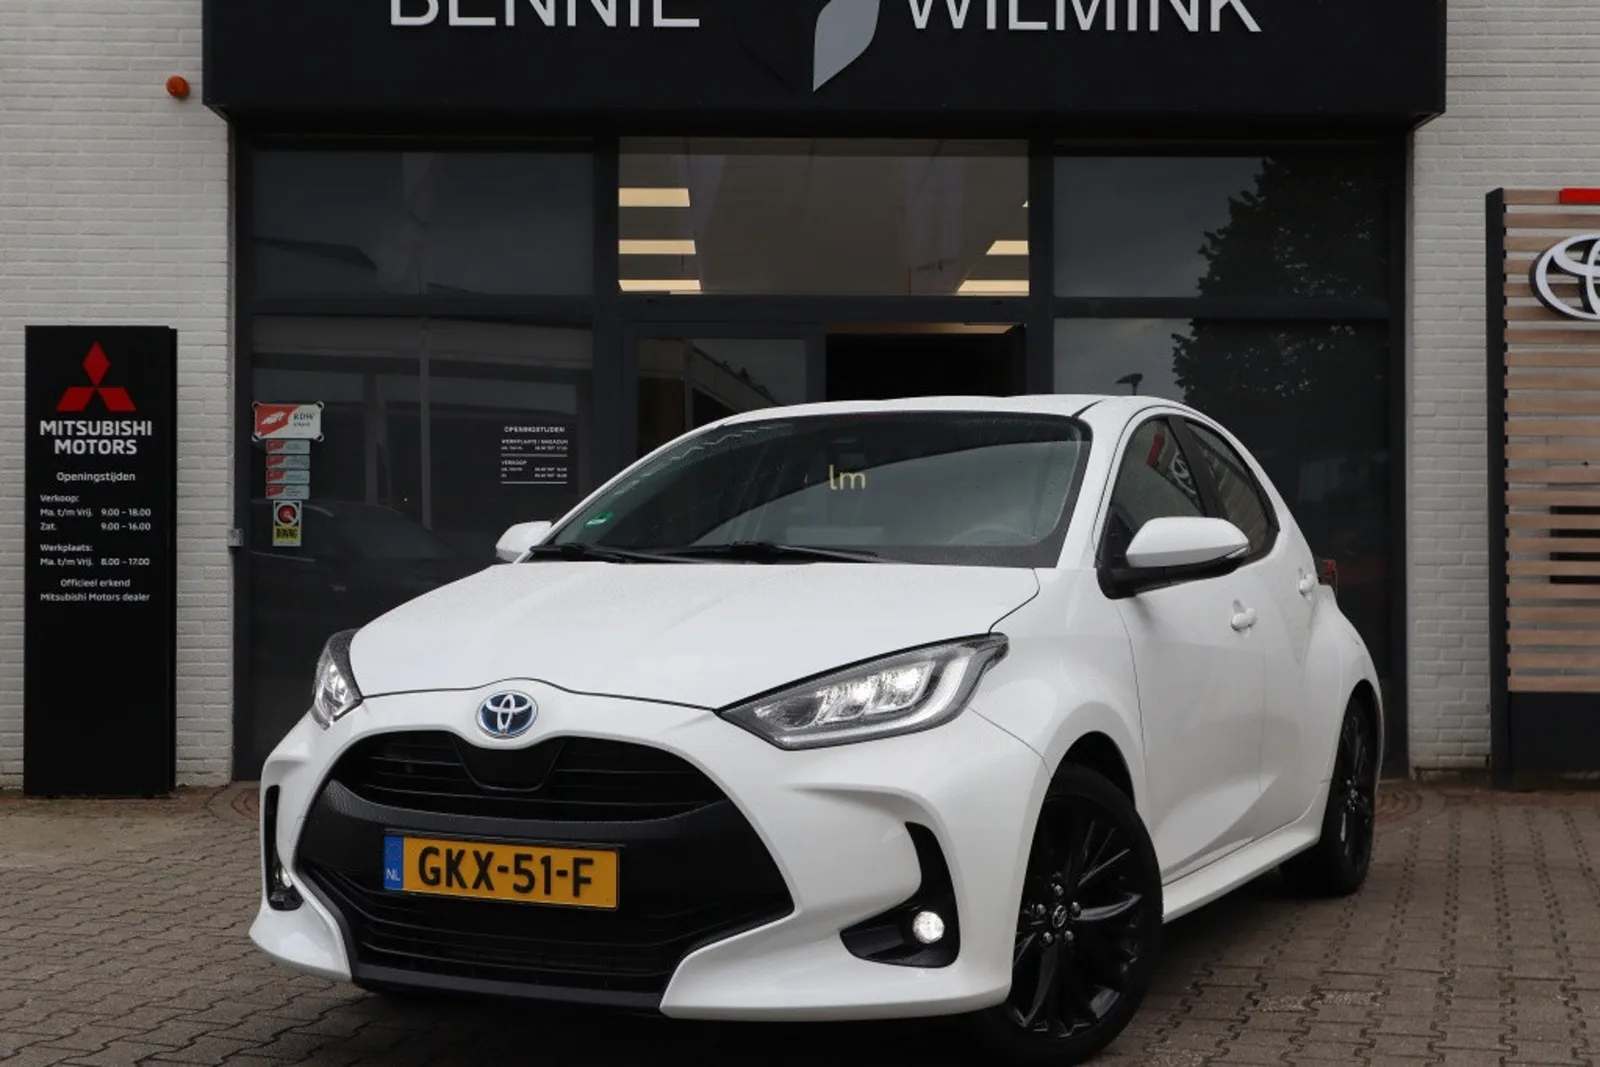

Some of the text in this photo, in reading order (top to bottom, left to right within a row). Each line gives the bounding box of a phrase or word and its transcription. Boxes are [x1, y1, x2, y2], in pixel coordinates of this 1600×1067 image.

[40, 420, 152, 436] MITSUBISHI
[54, 439, 137, 455] MOTORS
[56, 472, 136, 483] Openingstijden
[40, 494, 80, 504] Verkoop:
[40, 508, 56, 517] Ma.
[57, 508, 76, 518] t/m
[128, 508, 151, 517] 18.00
[40, 522, 57, 531] Zat.
[40, 544, 93, 553] Werkplaats:
[40, 558, 56, 567] Ma.
[57, 558, 76, 568] t/m
[60, 579, 131, 587] Officieel erkend
[40, 593, 151, 602] Mitsubishi Motors dealer
[386, 846, 594, 898] NL GKX-51-F
